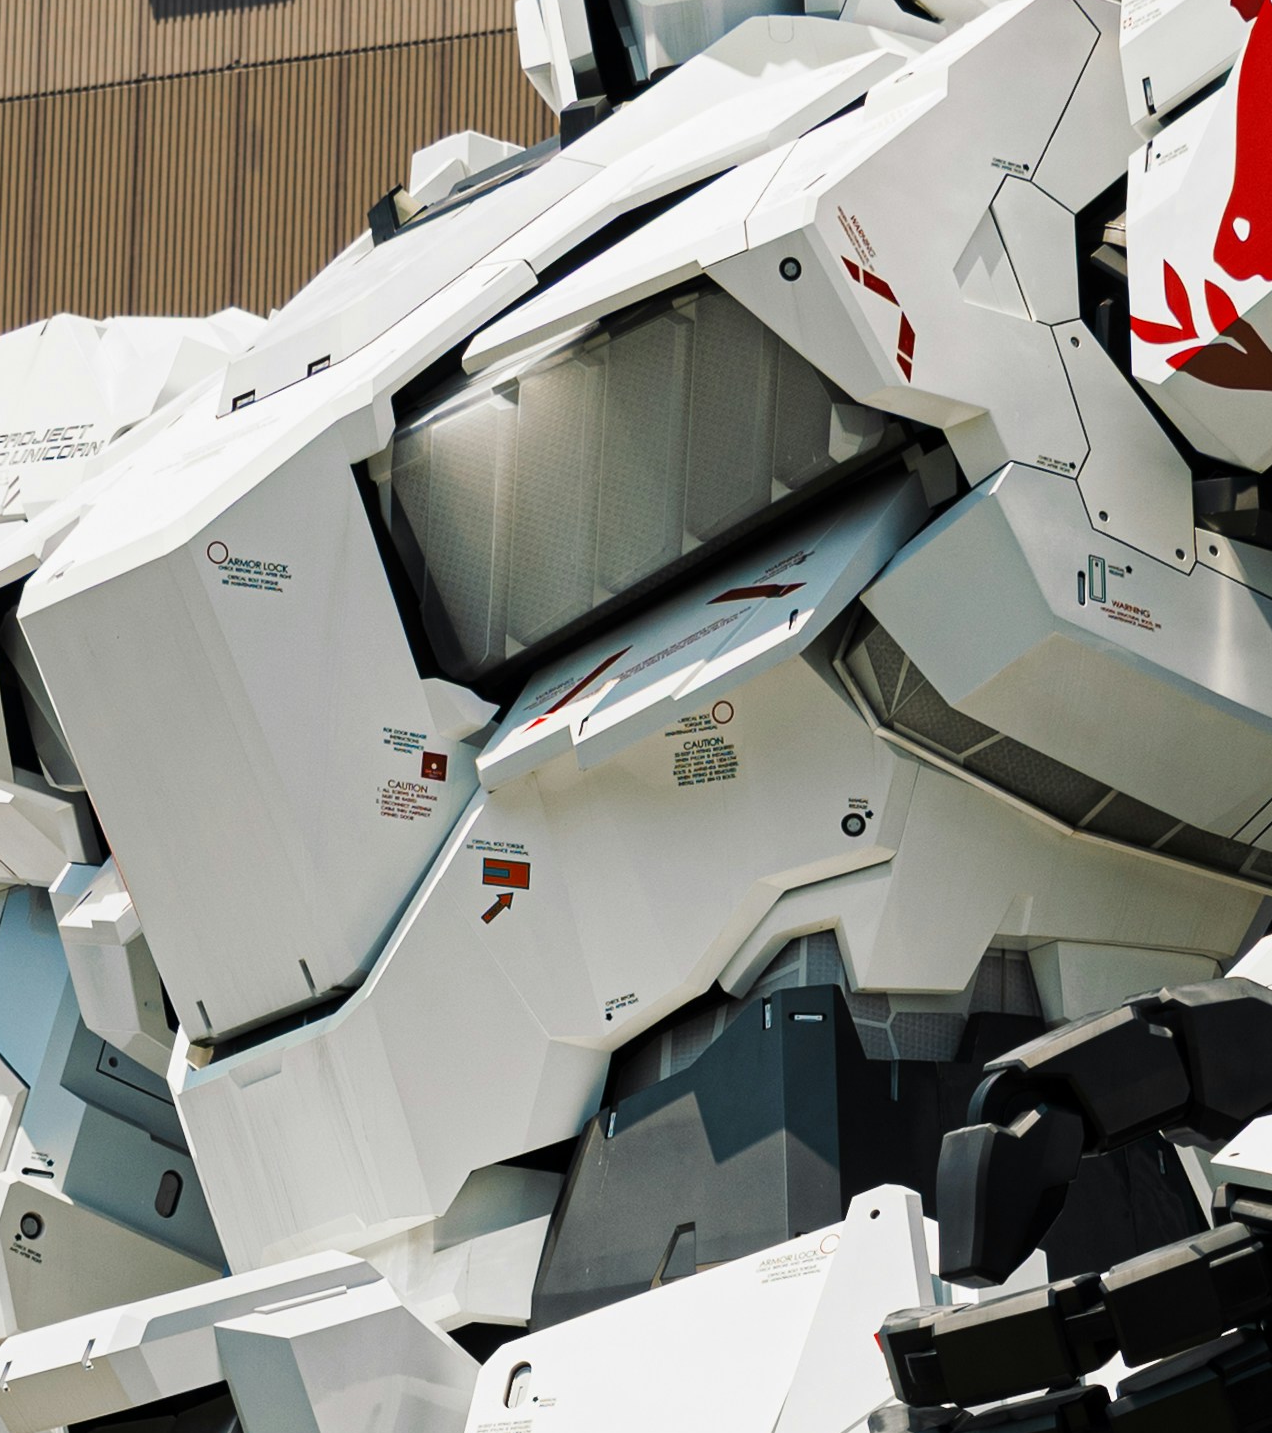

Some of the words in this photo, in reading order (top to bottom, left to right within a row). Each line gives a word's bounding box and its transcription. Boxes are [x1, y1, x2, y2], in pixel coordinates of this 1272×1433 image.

[8, 441, 104, 465] UNICORN
[227, 557, 262, 570] ARMOR
[263, 562, 288, 574] LOCK
[1112, 600, 1151, 618] WARNING
[683, 736, 724, 751] CAUTION
[387, 779, 428, 794] CAUTION
[760, 1254, 793, 1267] ARMOR
[794, 1249, 821, 1264] LOCK
